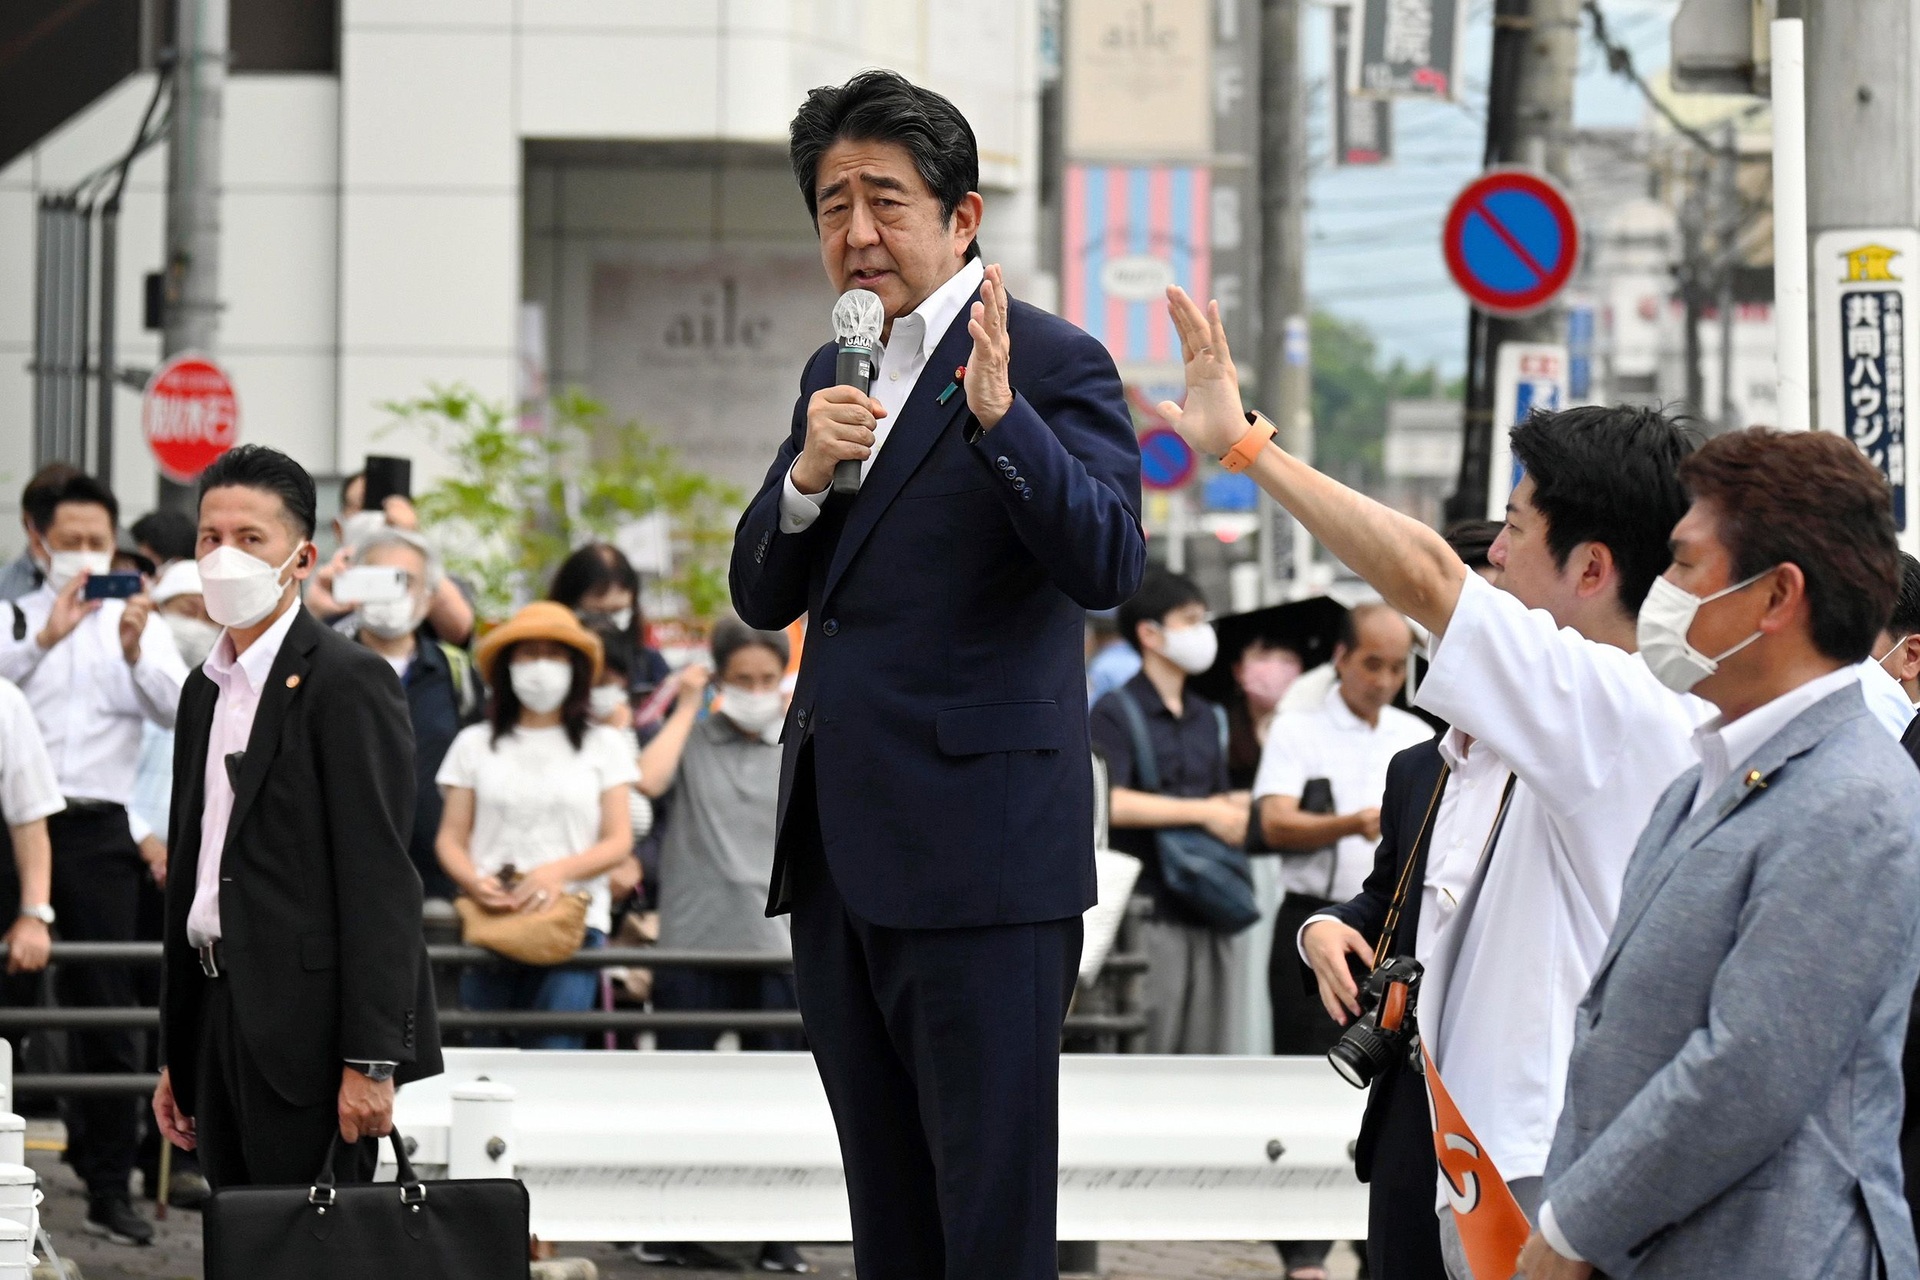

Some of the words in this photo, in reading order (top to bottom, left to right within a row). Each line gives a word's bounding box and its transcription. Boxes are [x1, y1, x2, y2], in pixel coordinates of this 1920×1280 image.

[663, 275, 774, 347] aile
[1847, 294, 1887, 481] 共同ハウジ
